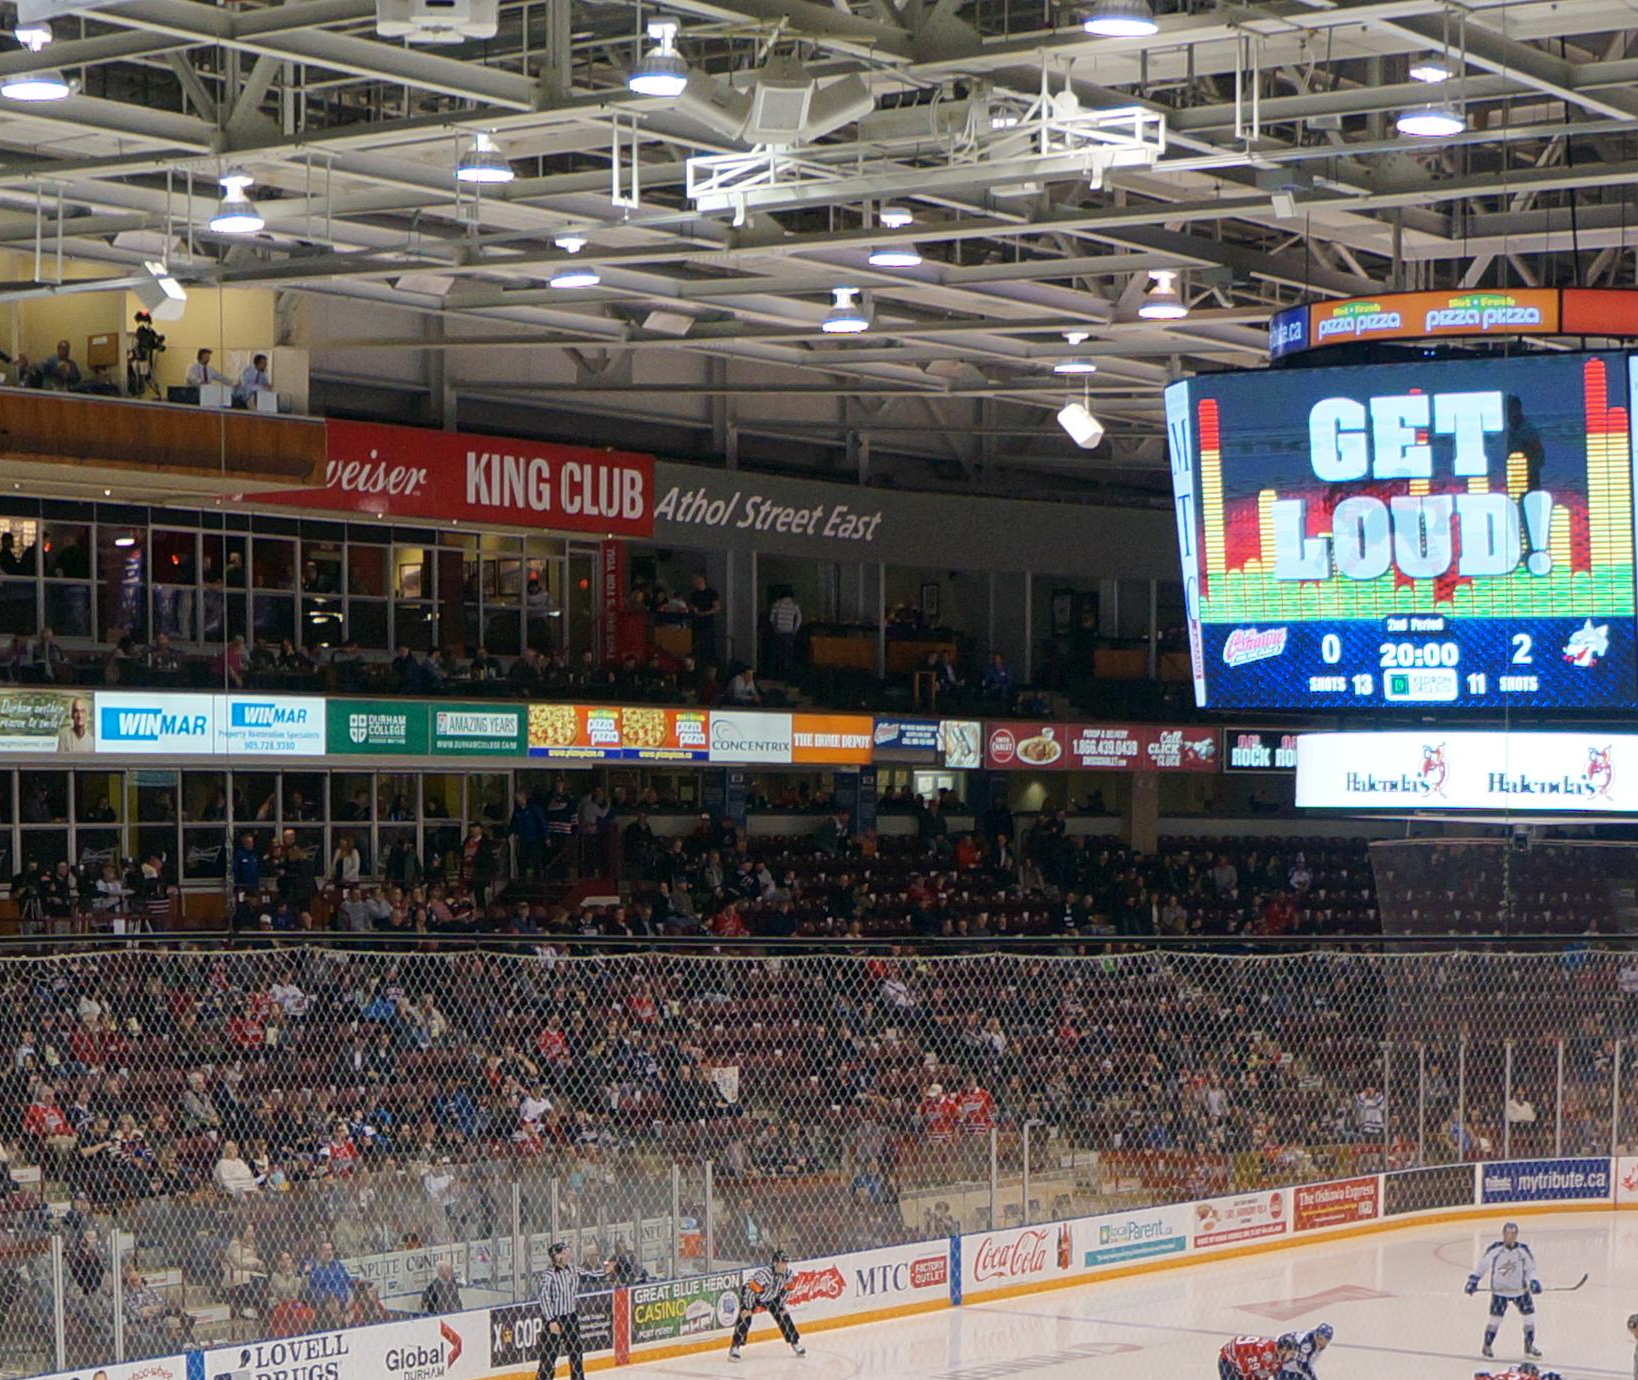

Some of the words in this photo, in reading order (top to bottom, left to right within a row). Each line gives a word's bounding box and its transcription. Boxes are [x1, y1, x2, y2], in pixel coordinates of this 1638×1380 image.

[1318, 317, 1355, 341] pizza
[1355, 313, 1401, 336] pizza
[1426, 308, 1480, 333] pizza
[1482, 304, 1541, 330] pizza
[1309, 390, 1504, 482] GET
[467, 450, 550, 513] KING
[561, 461, 644, 520] CLUB
[655, 487, 736, 527] Athol
[737, 494, 823, 536] Street
[824, 506, 882, 543] East
[1273, 490, 1554, 581] LOUD!
[1410, 618, 1444, 632] Period
[1322, 634, 1341, 664] 0
[1380, 642, 1459, 668] 20:00
[1511, 633, 1533, 664] 2
[1309, 676, 1347, 692] SHOTS
[1352, 674, 1373, 695] 13
[1467, 673, 1486, 695] 11
[1499, 675, 1538, 692] SHOTS
[119, 712, 207, 738] WINMAR
[244, 706, 307, 725] WINMAR
[369, 715, 407, 726] DURHAM
[449, 715, 488, 733] AMAZING
[490, 716, 517, 733] YEARS
[369, 725, 407, 737] COLLEGE
[794, 733, 813, 747] THE
[815, 734, 840, 748] HOME
[842, 735, 871, 749] DEPOT
[713, 740, 789, 752] CONCENTRIX
[1231, 747, 1270, 767] ROCK
[1346, 771, 1430, 793] Halenda's
[1487, 773, 1595, 795] Halenda's
[1517, 1171, 1607, 1192] mytribute.ca
[914, 1261, 945, 1275] FACTORY
[915, 1270, 945, 1285] OUTLET
[634, 1284, 670, 1303] GREAT
[672, 1279, 699, 1298] BLUE
[703, 1274, 740, 1293] HERON
[855, 1262, 909, 1298] MTC
[634, 1299, 687, 1325] CASINO
[255, 1335, 349, 1369] LOVELL
[385, 1342, 445, 1372] Global
